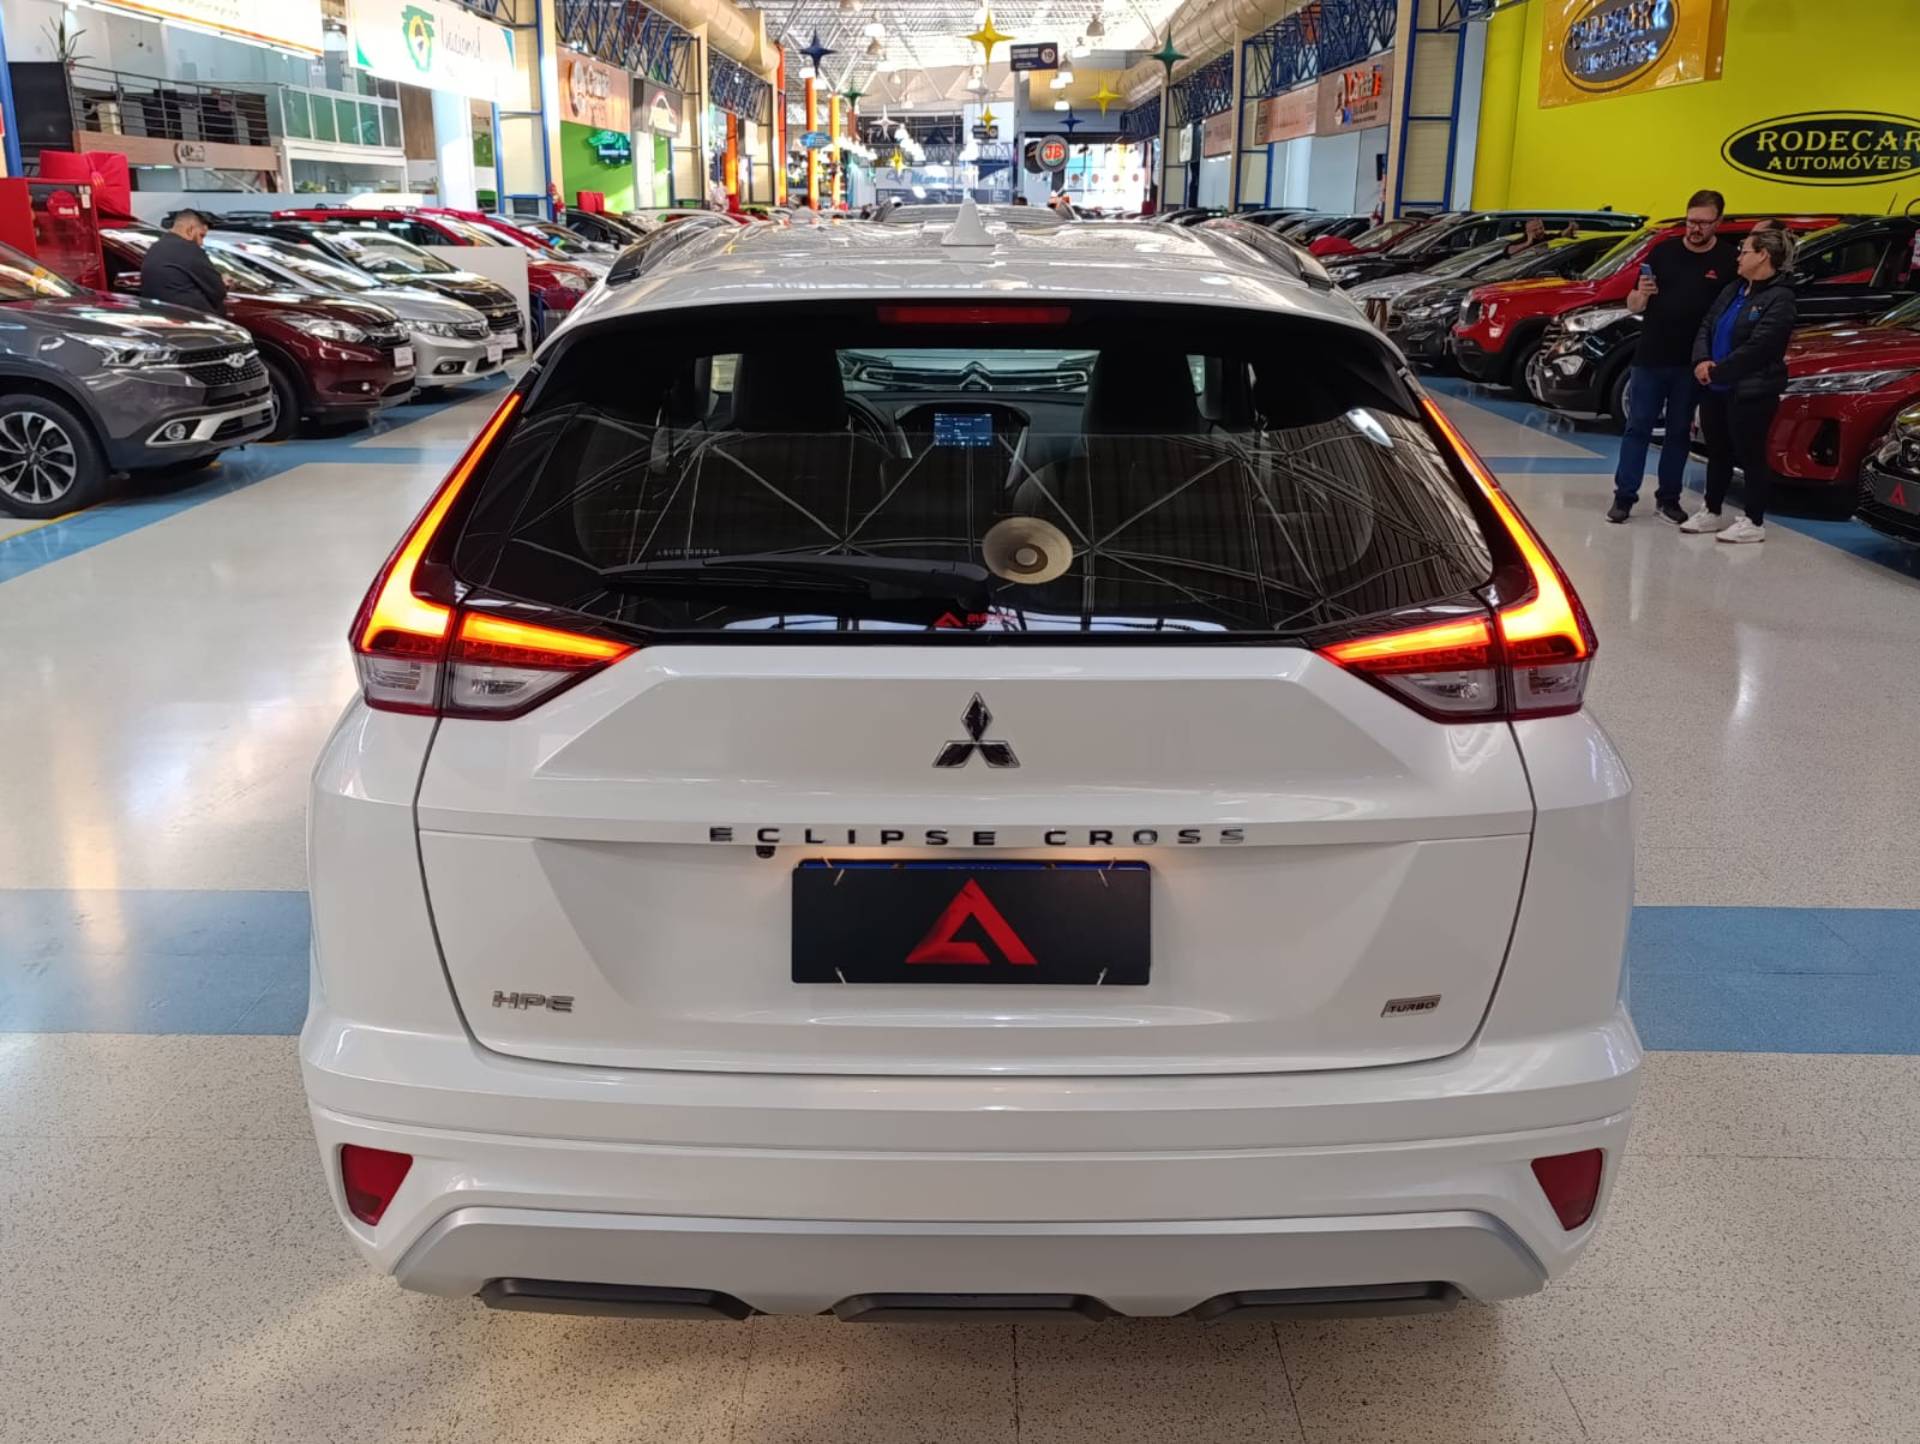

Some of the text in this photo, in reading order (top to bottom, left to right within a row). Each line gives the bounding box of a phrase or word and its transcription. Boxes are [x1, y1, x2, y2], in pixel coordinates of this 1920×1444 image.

[1756, 130, 1920, 153] RODECAR
[1766, 151, 1912, 171] AUTOMÓVEIS
[709, 827, 1245, 846] ECLIPSE CROSS
[492, 990, 574, 1013] HPE
[1390, 1001, 1436, 1013] TURBO
